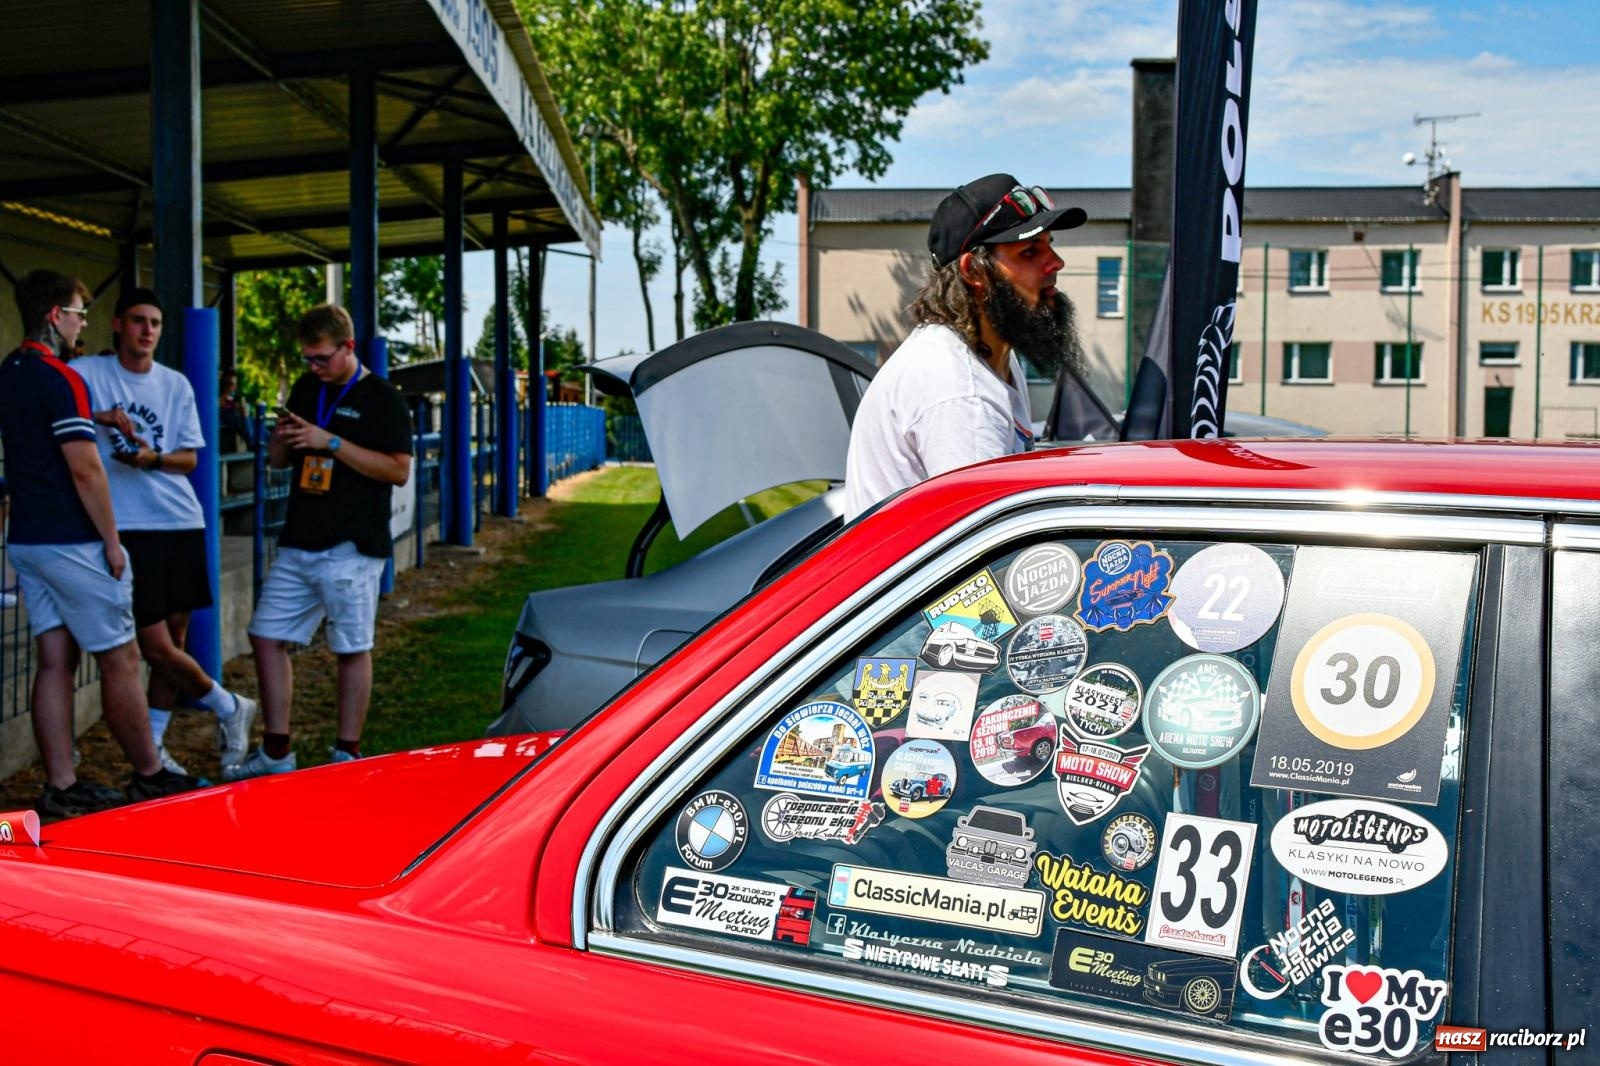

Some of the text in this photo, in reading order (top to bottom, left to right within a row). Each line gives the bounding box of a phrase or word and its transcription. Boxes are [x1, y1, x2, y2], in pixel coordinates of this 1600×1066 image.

[1482, 302, 1511, 323] KS
[1516, 302, 1560, 324] 1905
[128, 402, 157, 424] AND
[1101, 548, 1127, 567] NOCNA
[1103, 555, 1129, 573] JAZDA
[1017, 559, 1068, 588] NOCNA
[1090, 561, 1159, 604] Summer Night
[928, 575, 989, 620] RUDZKO
[962, 584, 994, 608] RAJZA
[1019, 574, 1070, 605] JAZDA
[1197, 573, 1250, 621] 22
[1197, 664, 1218, 676] AMS
[1320, 652, 1401, 709] 30
[1072, 694, 1120, 716] 2021
[1075, 685, 1124, 707] KLASYKFEST
[773, 725, 787, 740] Do
[786, 703, 835, 729] Siewierza
[980, 704, 1038, 727] ZAKOŃCZENIE
[1079, 720, 1108, 735] TYCHY
[976, 721, 1009, 735] SEZONU
[1080, 744, 1120, 761] 17-18.07.2021
[1160, 732, 1235, 749] ARENA MOTO SHOW
[974, 748, 997, 760] 2019
[1270, 755, 1354, 776] 18.05.2019
[1060, 754, 1133, 785] MOTO SHOW
[1269, 770, 1350, 786] www.ClassicMania.pl
[767, 776, 797, 788] spotkania
[798, 779, 827, 792] pojazdów
[828, 783, 846, 793] epoki
[686, 794, 744, 844] BMW-e30.PL
[784, 800, 859, 815] rozpoczęcie
[783, 813, 826, 827] sezonu
[1299, 814, 1424, 844] MOTOLEGENDS
[1104, 815, 1155, 855] KLASYKFEST 2022
[681, 844, 713, 870] Forum
[948, 858, 984, 871] VALCAS
[987, 865, 1027, 880] GARAGE
[1288, 848, 1425, 872] KLASYKI NA NOWO
[1037, 855, 1147, 906] Wataha
[1161, 824, 1242, 929] 33
[1302, 867, 1406, 886] WWW.MOTOLEGENDS.PL
[728, 892, 774, 909] ZDWÓRZ
[854, 878, 1006, 922] ClassicMania.pl
[1053, 889, 1141, 934] Events
[695, 899, 770, 936] Meeting
[1269, 898, 1336, 956] Nocna
[725, 924, 759, 936] POLAND
[850, 921, 944, 950] Klasyczna
[951, 939, 1043, 965] Niedziela
[1276, 915, 1342, 976] Jazda
[864, 944, 985, 981] NIETYPOWE SEATY
[1289, 928, 1356, 985] Gliwice
[1091, 960, 1141, 985] Meeting
[1110, 978, 1133, 987] POLAND
[1322, 971, 1443, 1015] I My
[1214, 1012, 1228, 1020] 2017
[1324, 1006, 1412, 1052] e30
